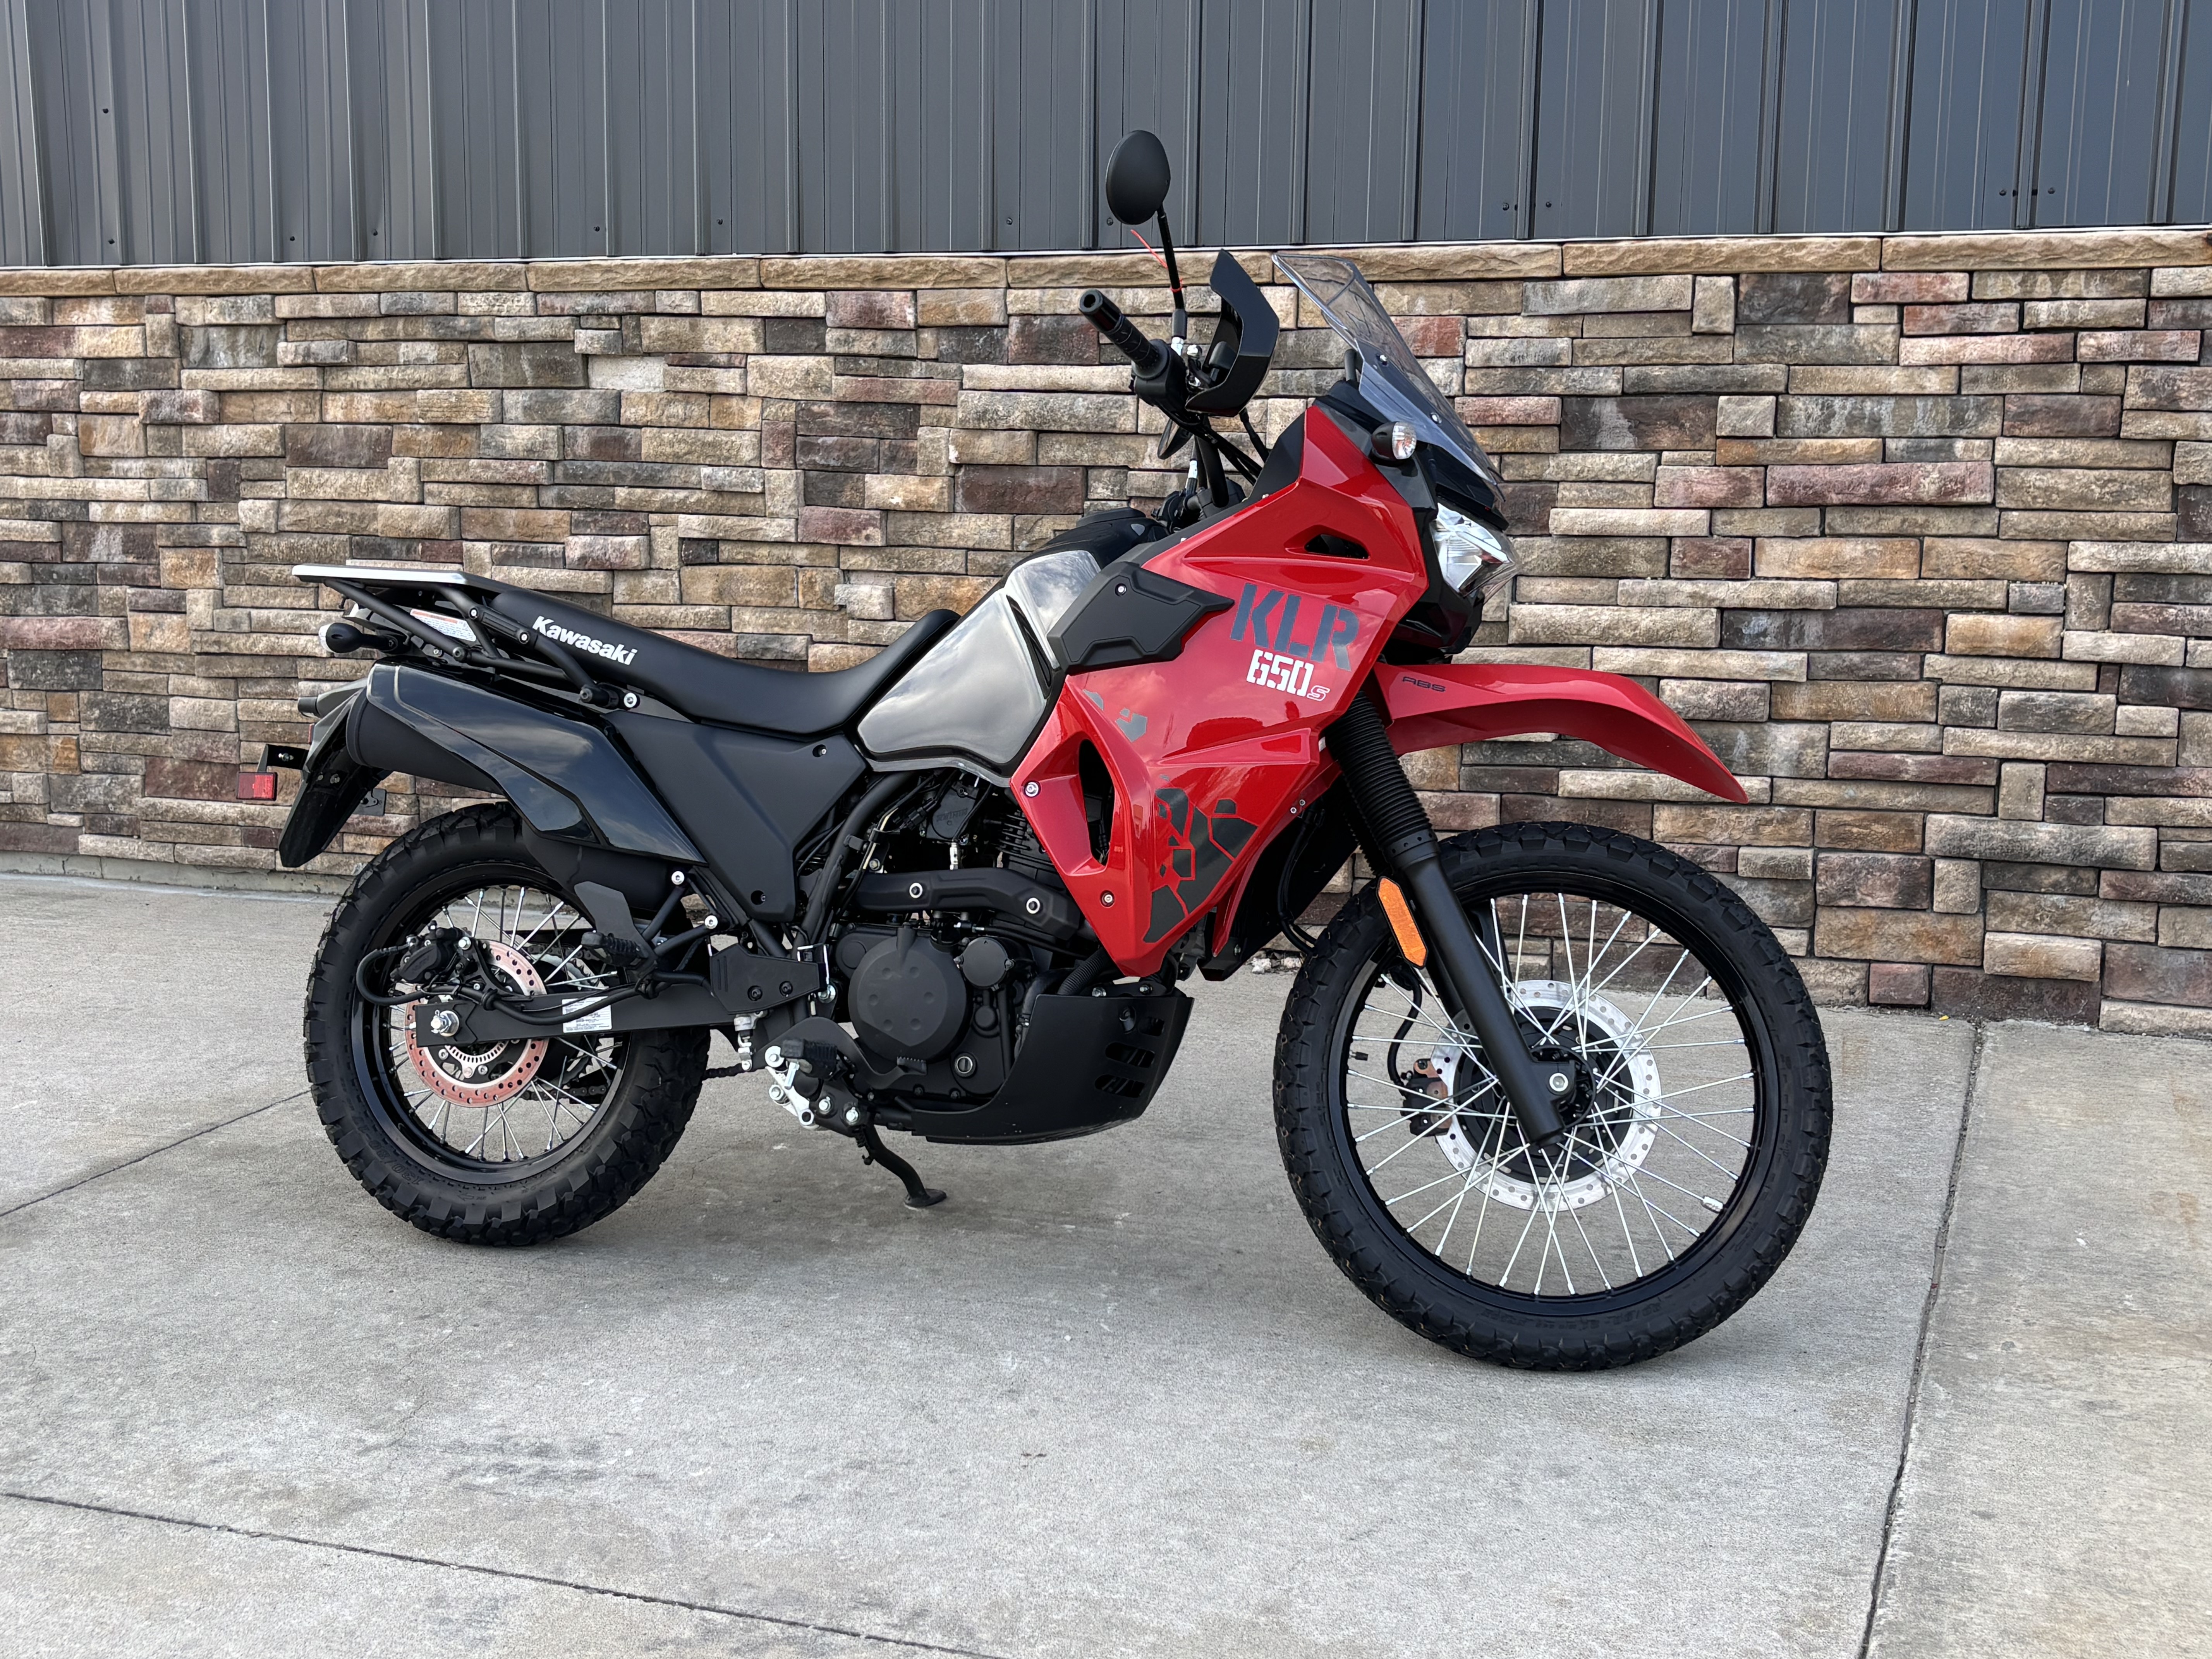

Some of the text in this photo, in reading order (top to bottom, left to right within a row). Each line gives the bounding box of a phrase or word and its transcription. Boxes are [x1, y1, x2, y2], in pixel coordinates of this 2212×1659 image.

[532, 616, 638, 665] Kawasaki
[1230, 582, 1360, 672] KLR
[1402, 676, 1446, 692] ABS
